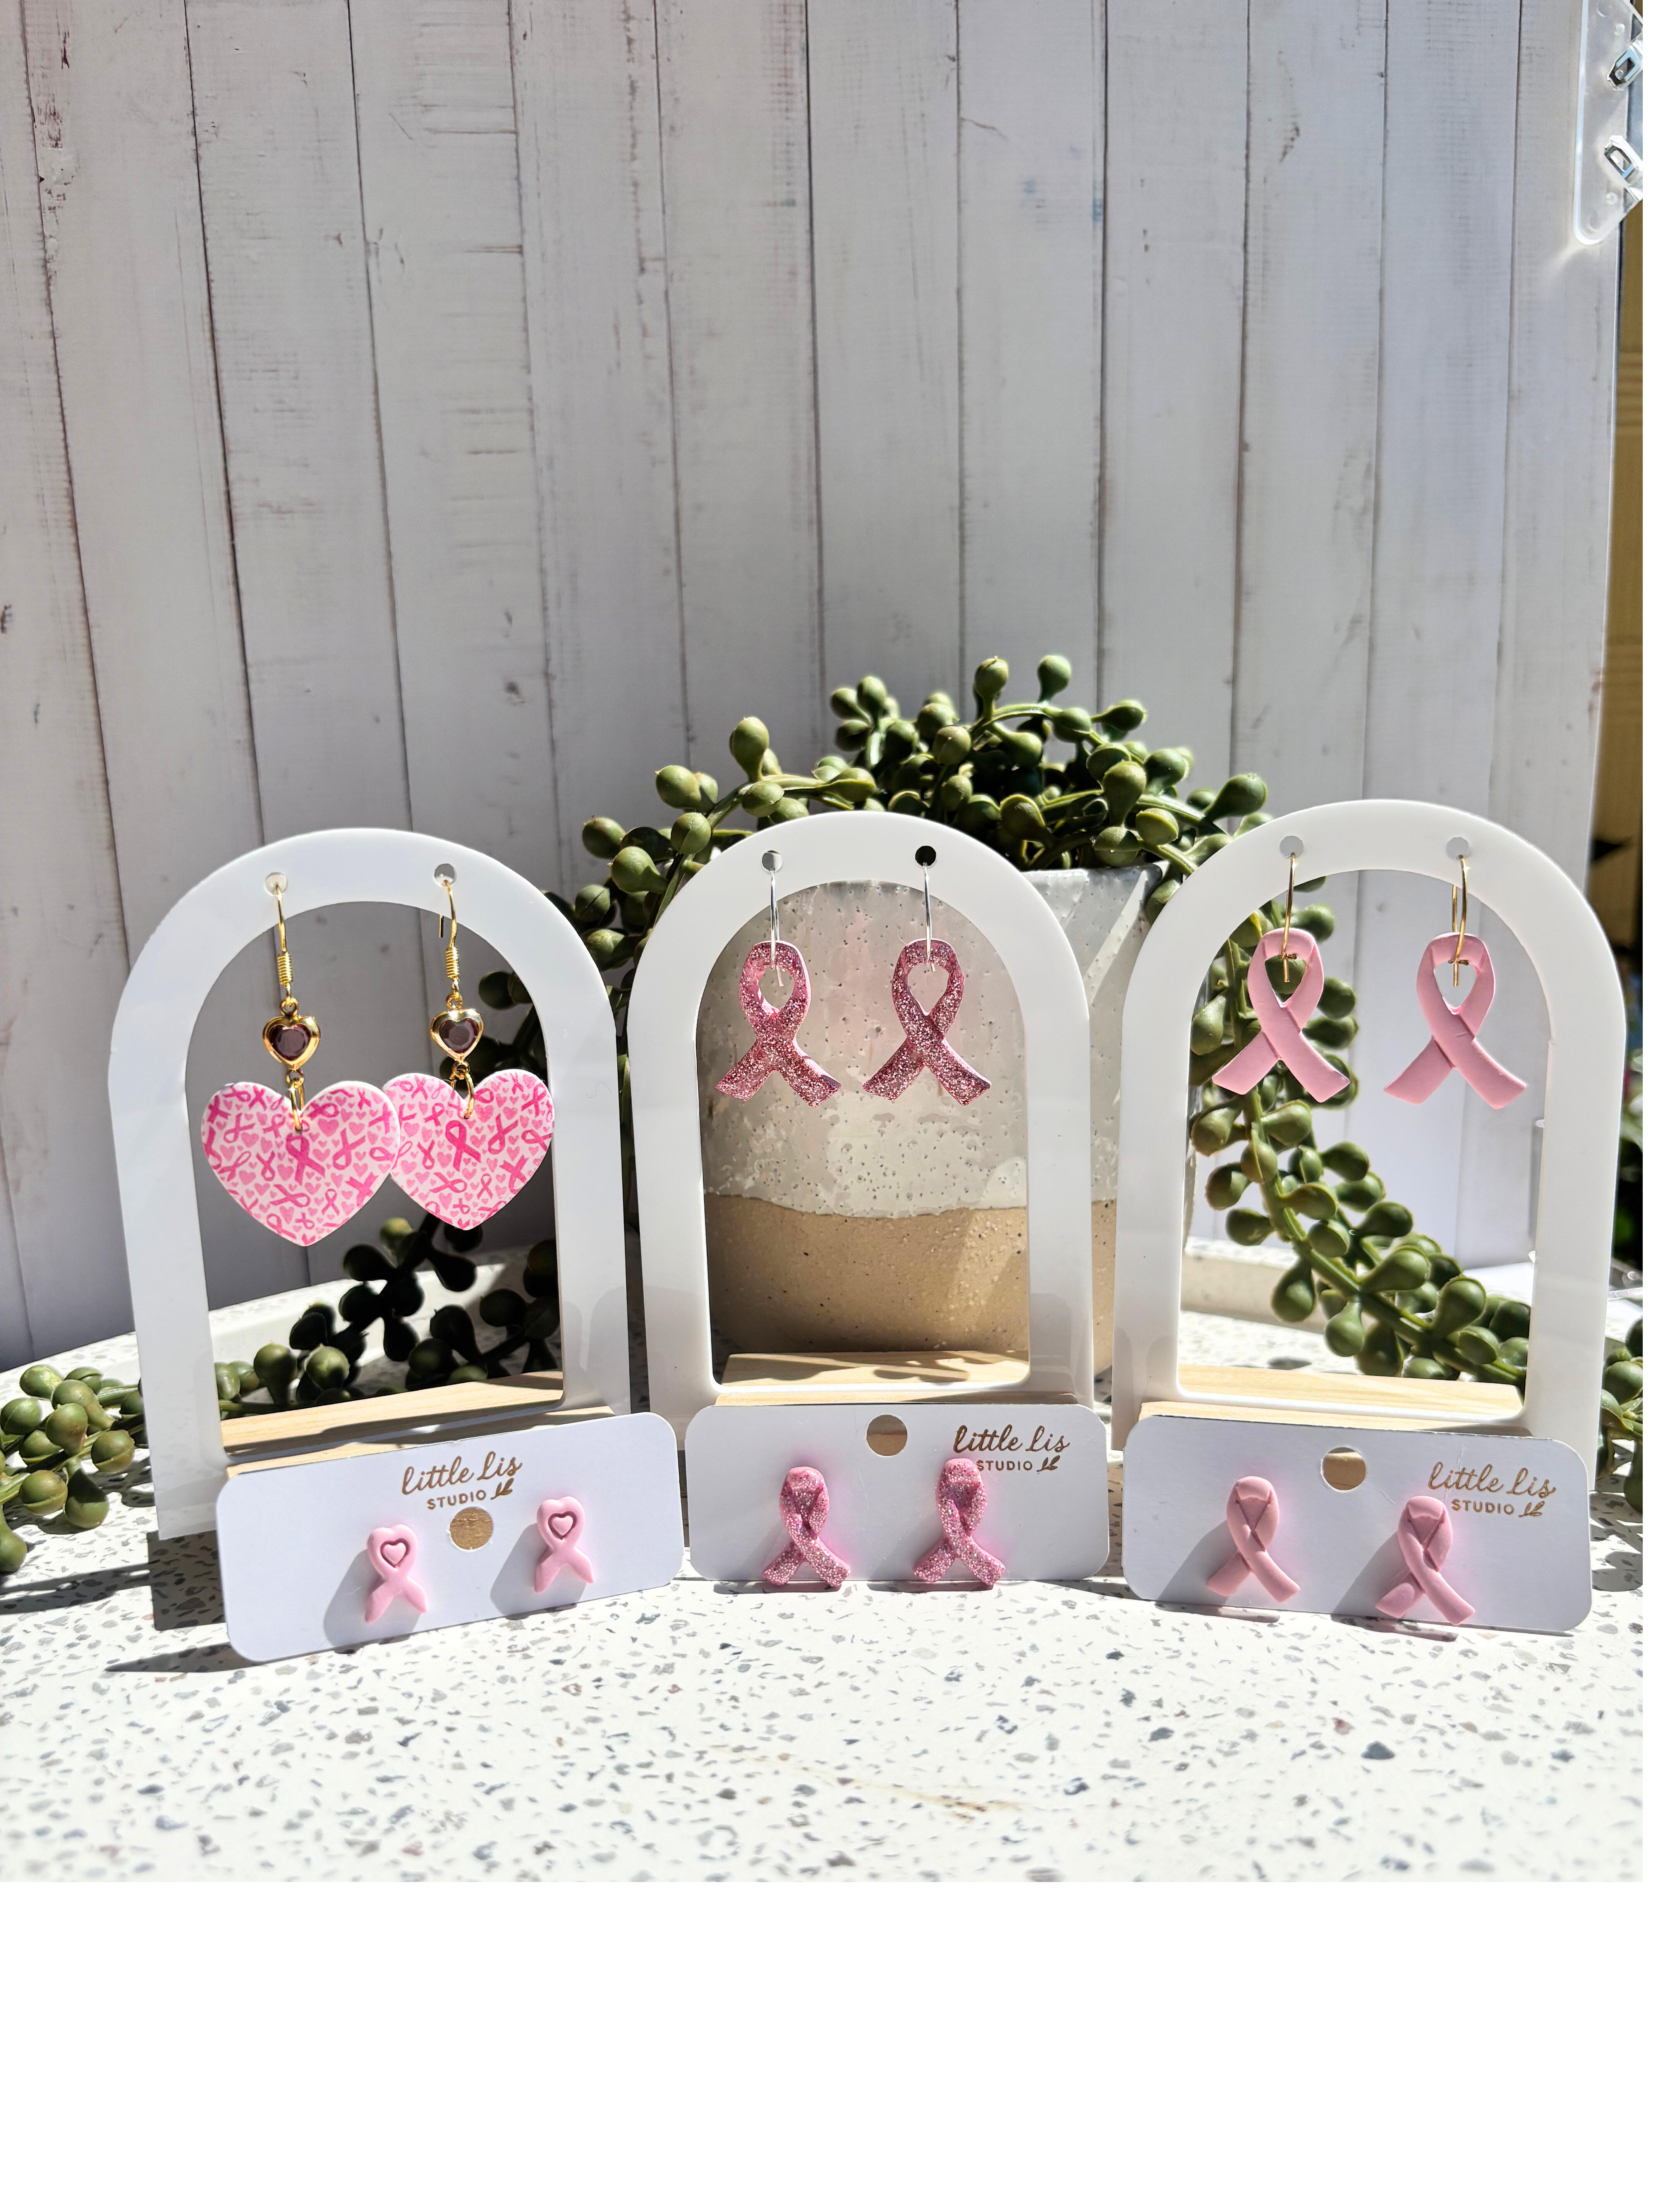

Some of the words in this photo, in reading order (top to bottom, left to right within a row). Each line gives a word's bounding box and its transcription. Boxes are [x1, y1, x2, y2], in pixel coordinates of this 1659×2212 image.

[953, 1424, 1023, 1453] little
[401, 1455, 475, 1495] little
[976, 1459, 1033, 1472] STUDIO
[1428, 1461, 1504, 1493] little
[427, 1489, 487, 1510] STUDIO
[1451, 1498, 1515, 1515] STUDIO
